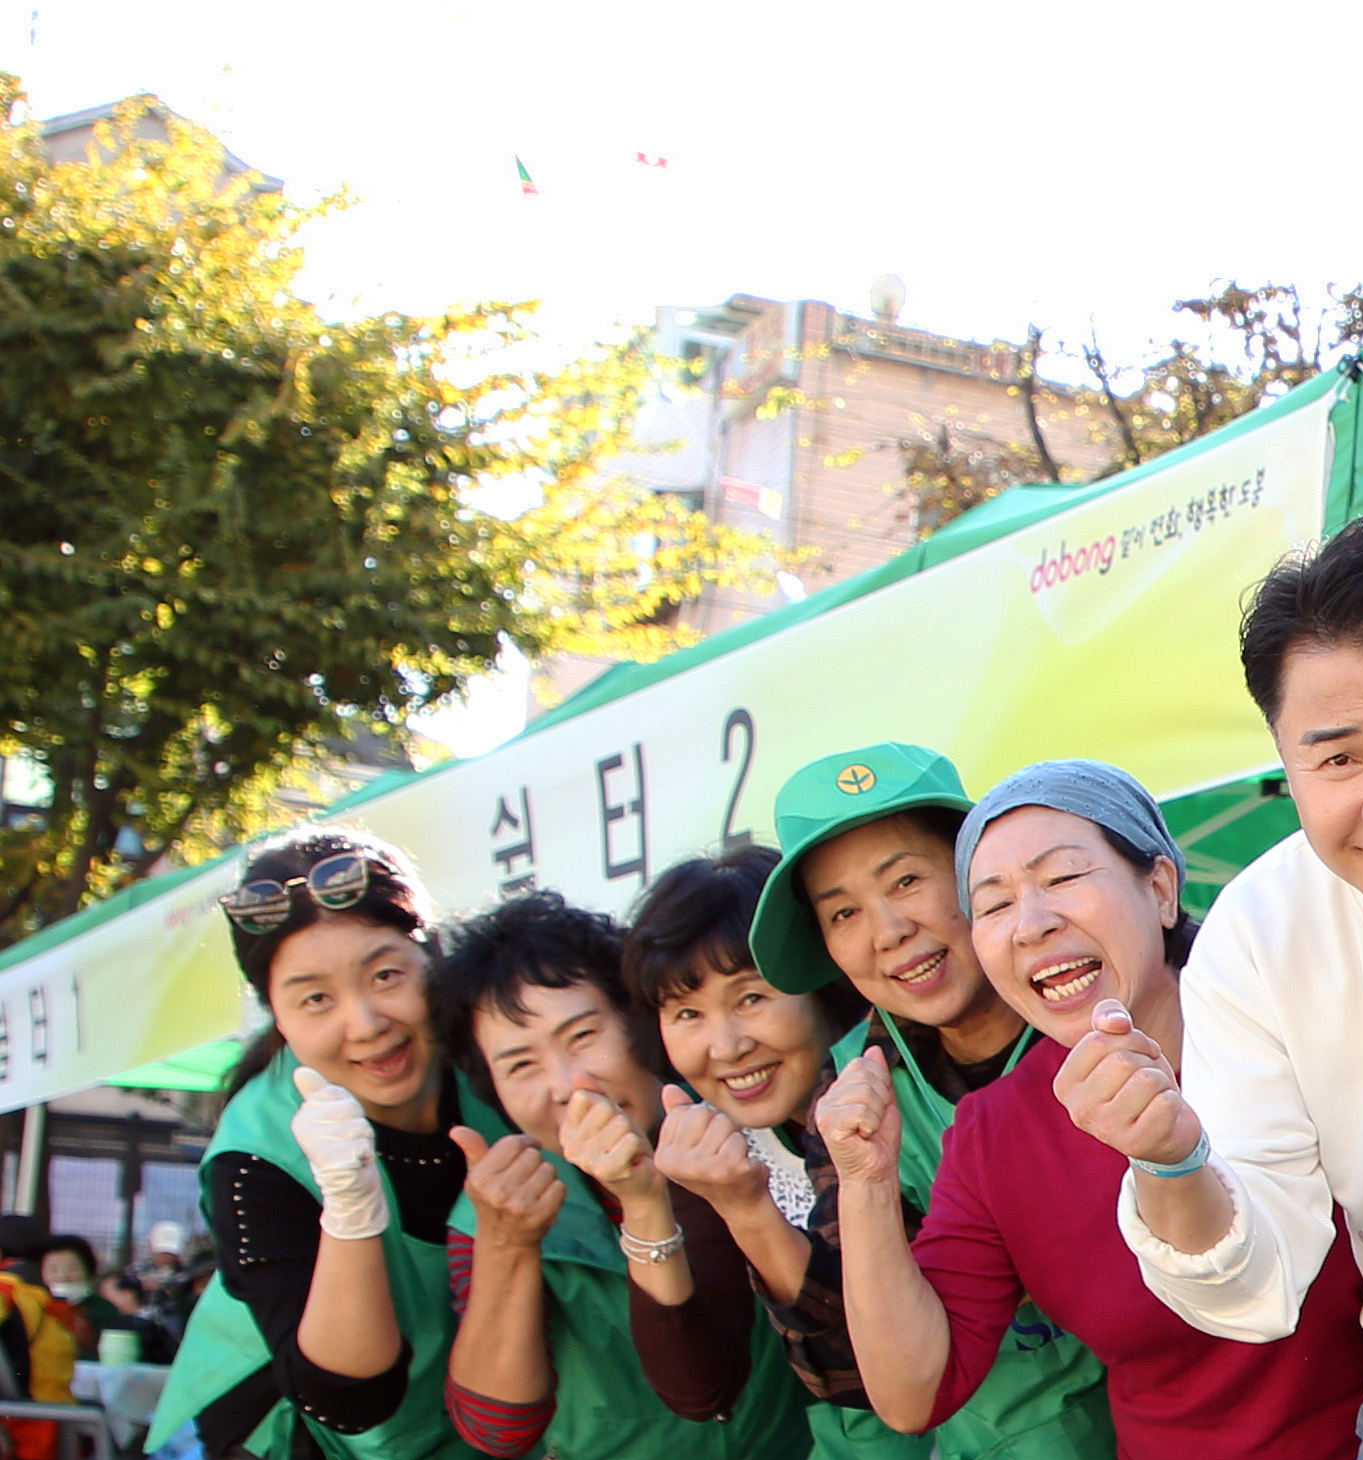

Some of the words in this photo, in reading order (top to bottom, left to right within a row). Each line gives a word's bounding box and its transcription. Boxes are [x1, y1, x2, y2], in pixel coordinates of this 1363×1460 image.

[1030, 537, 1117, 594] dobong
[1185, 484, 1237, 532] 행복한
[1238, 466, 1267, 509] 도봉
[720, 706, 758, 851] 2
